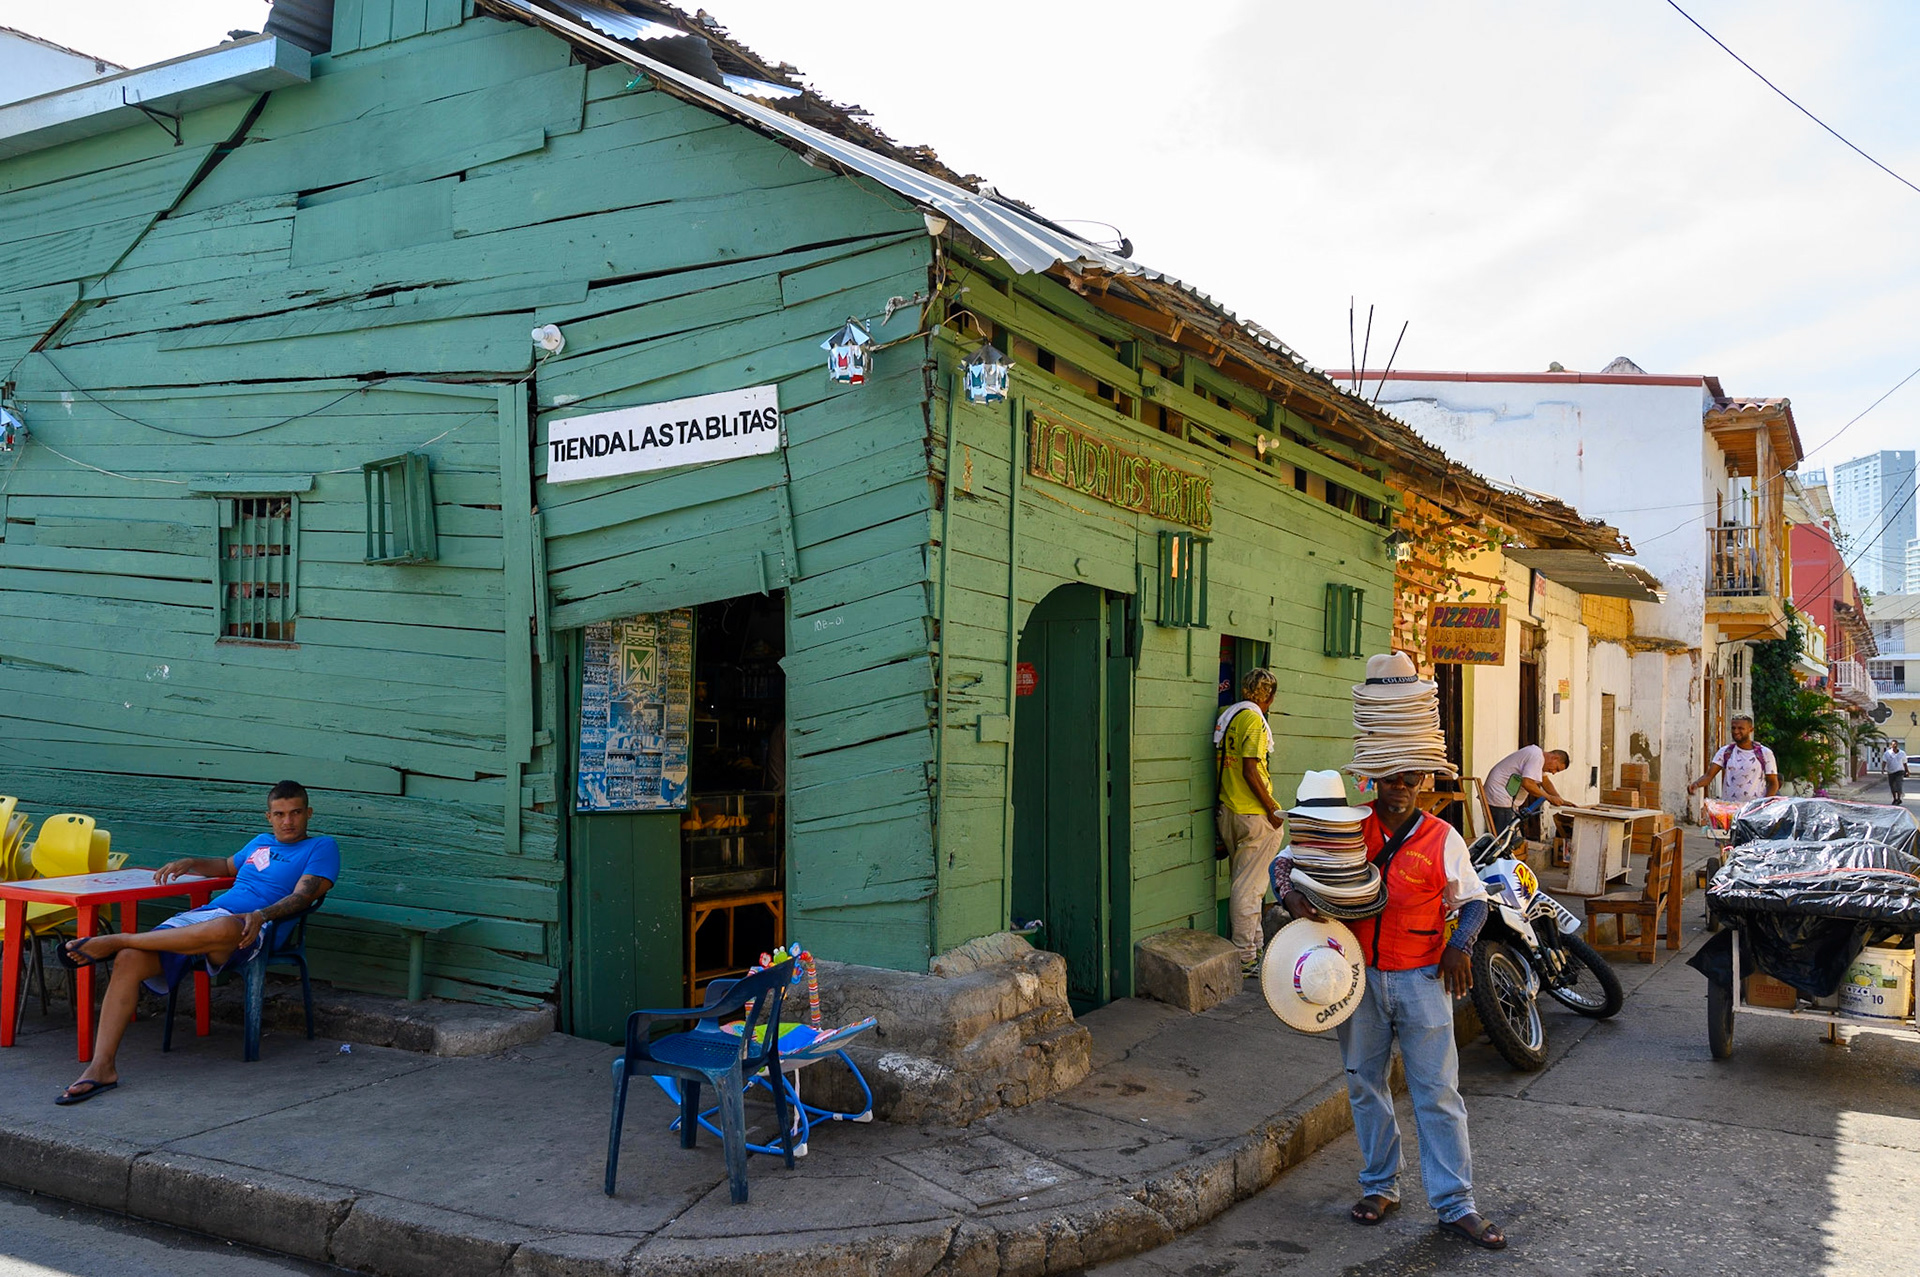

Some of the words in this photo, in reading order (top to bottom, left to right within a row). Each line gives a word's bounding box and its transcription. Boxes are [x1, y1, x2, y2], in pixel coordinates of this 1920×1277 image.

[629, 423, 674, 452] LAS
[676, 406, 778, 445] TABLITAS
[1111, 447, 1146, 508] LAS
[1148, 458, 1214, 529] TABLITAS
[1430, 606, 1500, 629] PIZZERIA
[1434, 629, 1453, 643] LAS
[1455, 630, 1497, 644] TABLITAS
[1431, 644, 1500, 662] Welcome
[1871, 994, 1884, 1005] 10
